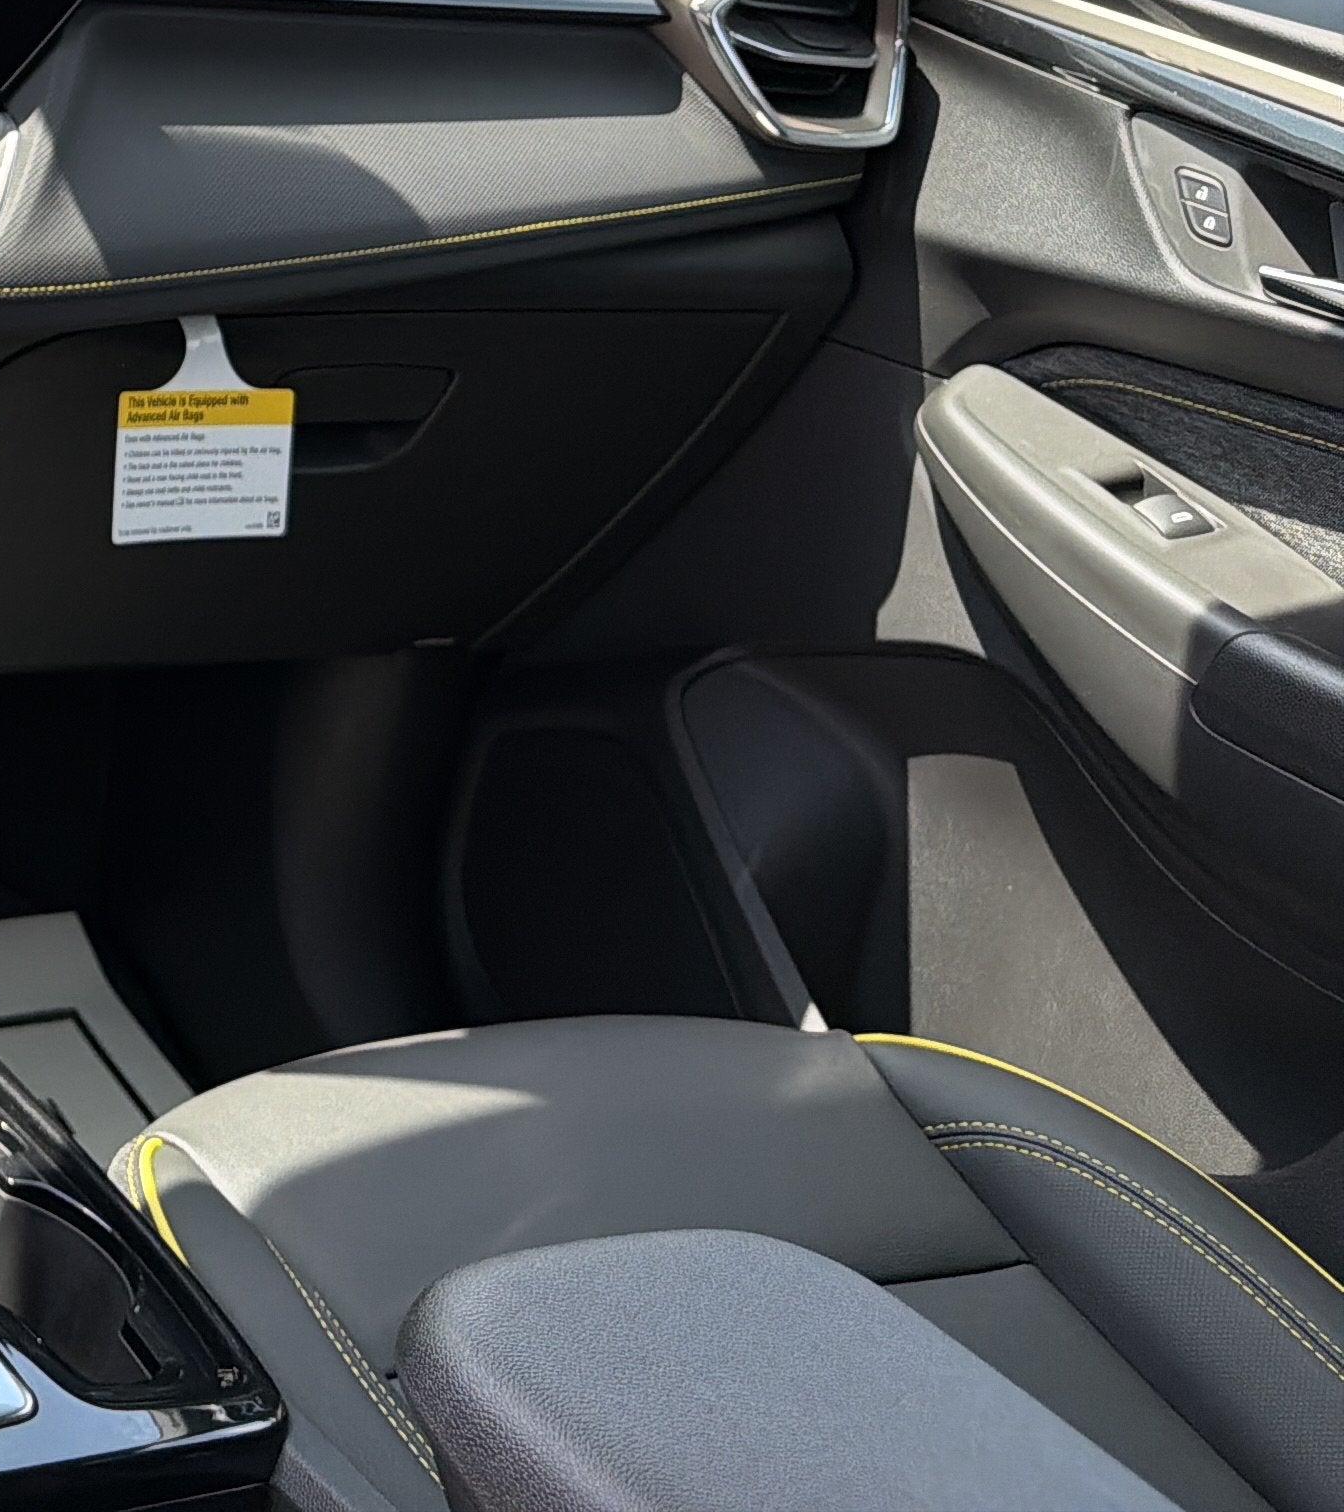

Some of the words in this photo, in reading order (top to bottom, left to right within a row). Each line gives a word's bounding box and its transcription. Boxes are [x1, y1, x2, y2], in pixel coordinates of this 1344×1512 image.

[128, 395, 146, 408] This
[148, 394, 176, 408] Vehicle
[179, 394, 186, 406] is
[188, 393, 227, 408] Equipped
[230, 393, 250, 406] with
[127, 410, 167, 424] Advanced
[169, 409, 181, 421] Air
[183, 408, 204, 422] Bags
